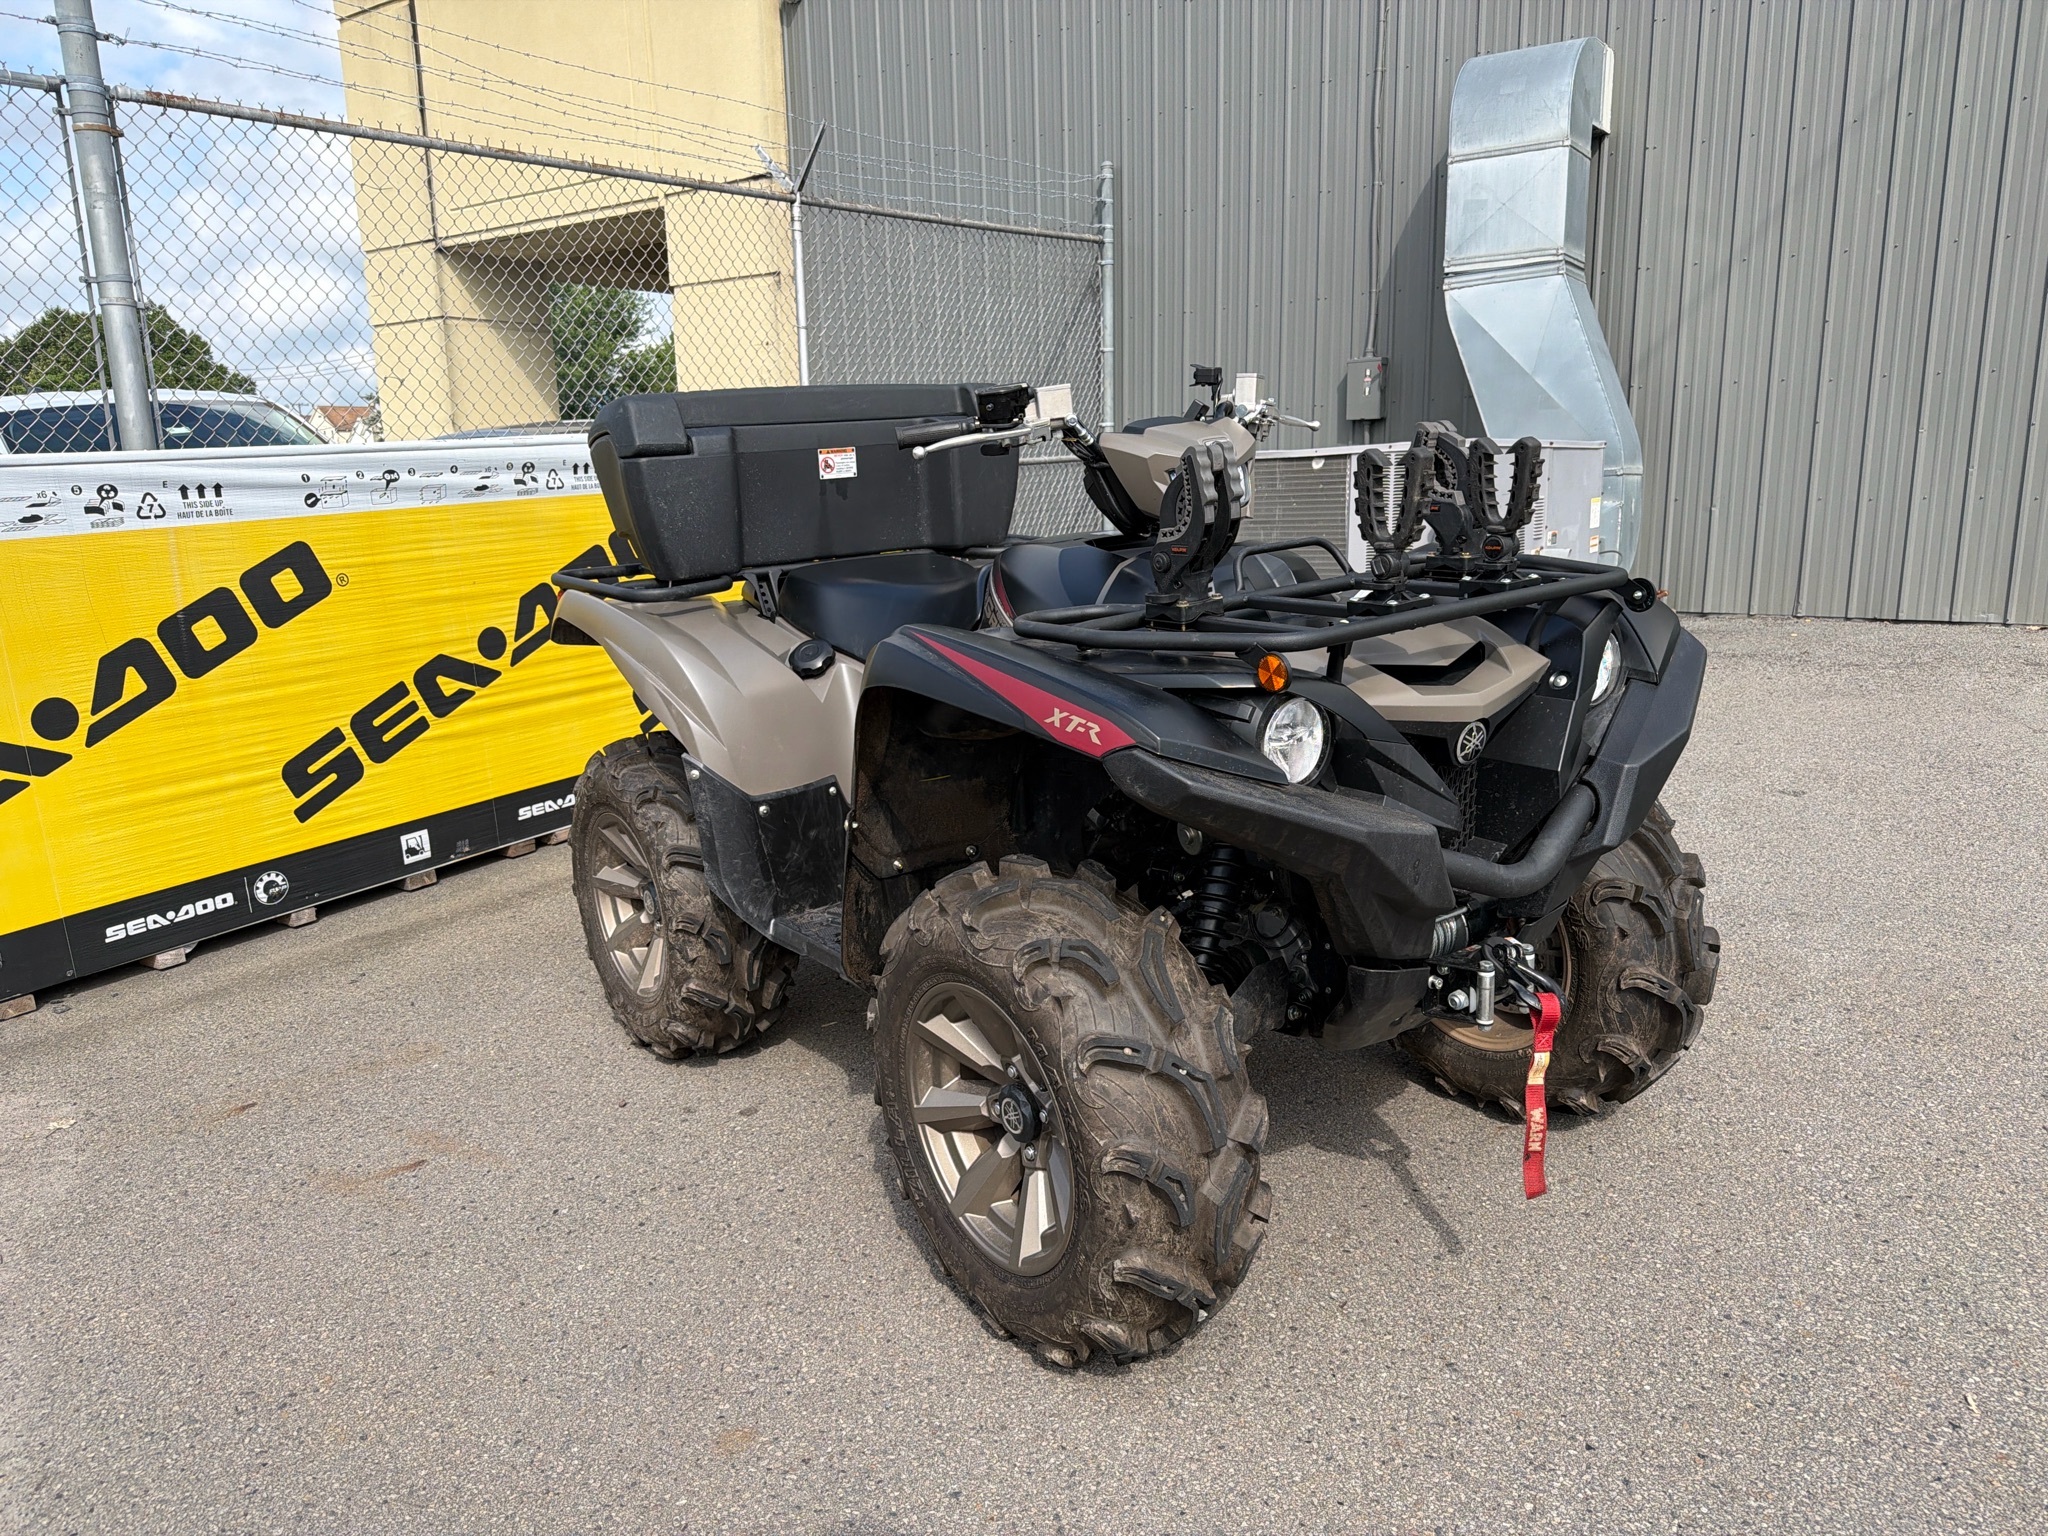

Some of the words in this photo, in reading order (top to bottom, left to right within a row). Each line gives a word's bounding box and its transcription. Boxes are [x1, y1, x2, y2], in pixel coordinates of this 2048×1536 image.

[36, 490, 48, 499] x6
[147, 503, 154, 514] 7
[183, 500, 198, 509] THIS
[200, 499, 214, 508] SIDE
[214, 499, 224, 507] UP
[177, 510, 194, 519] HAUT
[196, 510, 205, 518] DE
[206, 509, 213, 517] LA
[215, 506, 234, 517] BOÎTE
[1527, 1107, 1545, 1152] WARN
